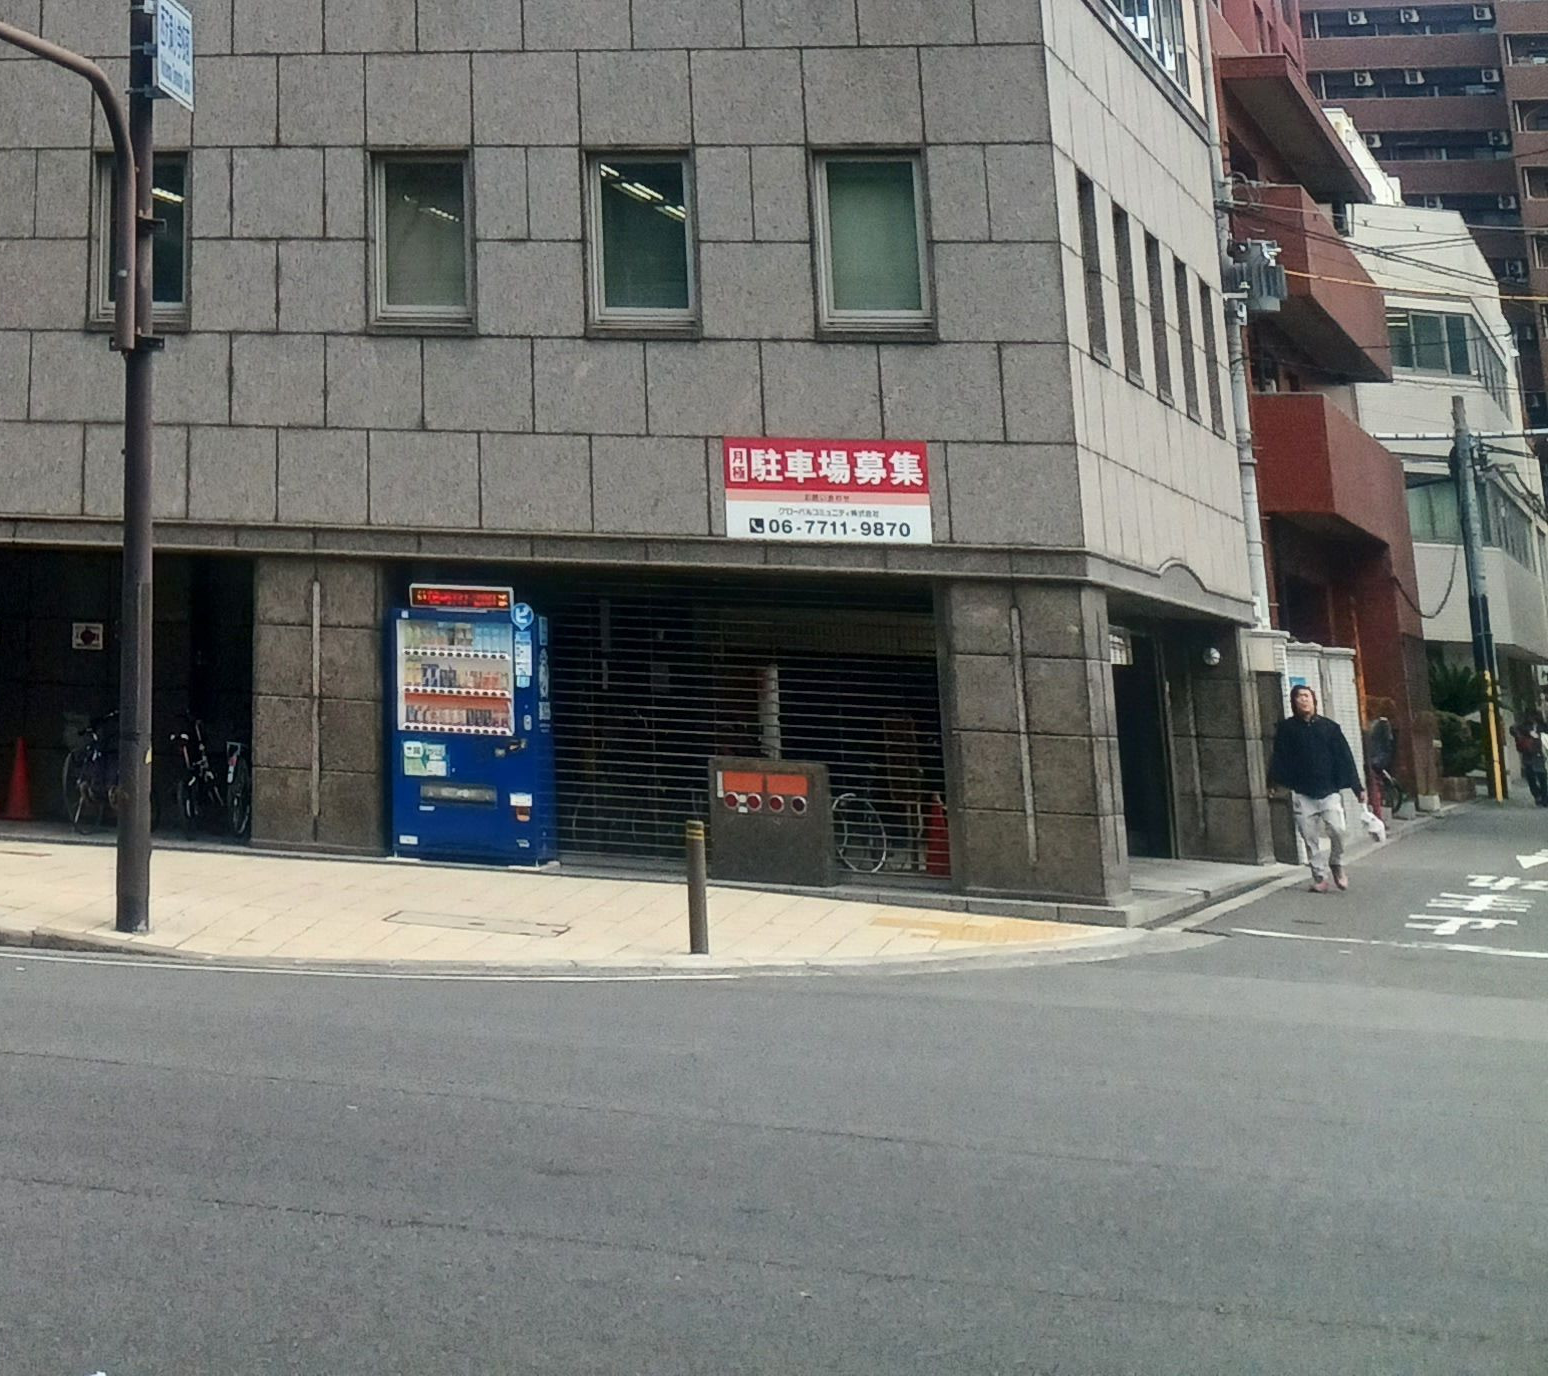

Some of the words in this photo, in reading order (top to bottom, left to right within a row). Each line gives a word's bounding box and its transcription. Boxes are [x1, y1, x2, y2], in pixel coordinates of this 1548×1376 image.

[750, 448, 925, 487] 駐車場募集
[768, 519, 911, 538] 06-7711-9870
